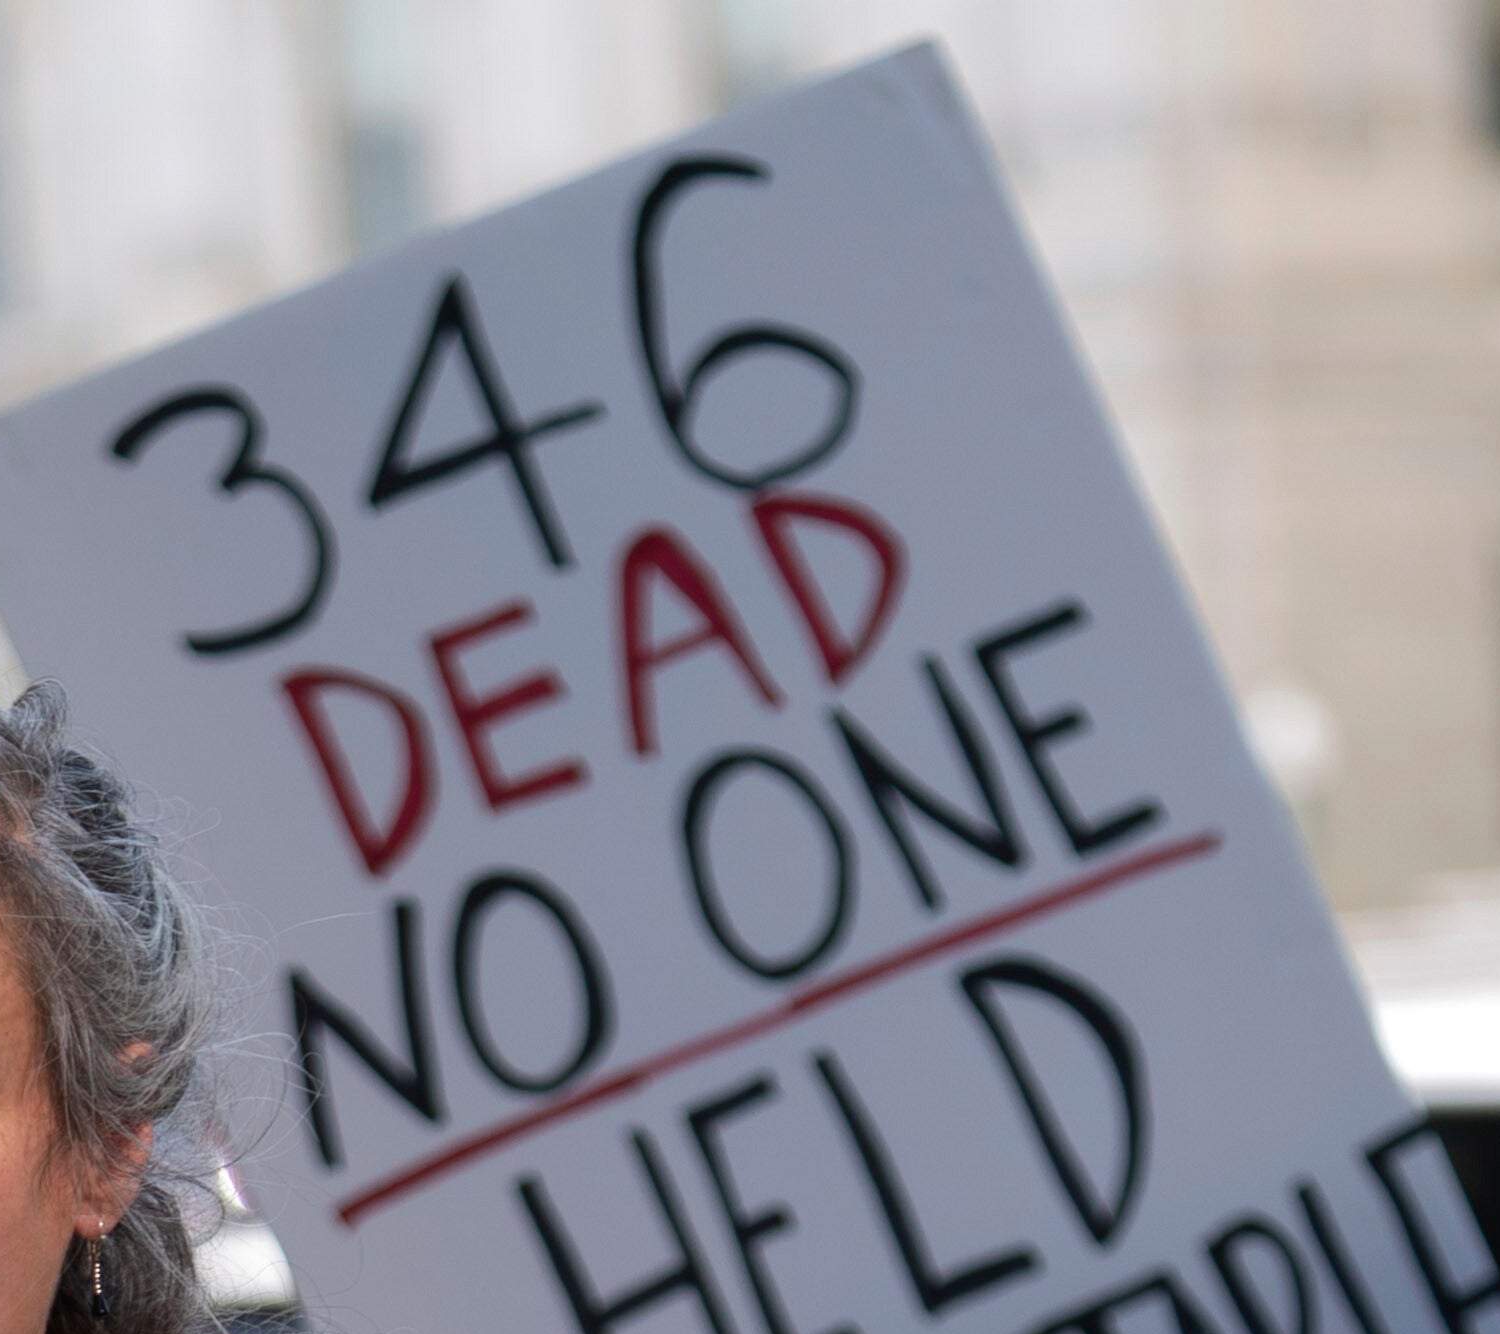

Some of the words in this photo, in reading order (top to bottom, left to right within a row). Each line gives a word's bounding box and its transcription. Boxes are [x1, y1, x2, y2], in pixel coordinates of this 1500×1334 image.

[105, 148, 860, 658] 346
[281, 488, 908, 878] DEAD
[286, 864, 616, 1170] NO
[676, 600, 1168, 980] ONE
